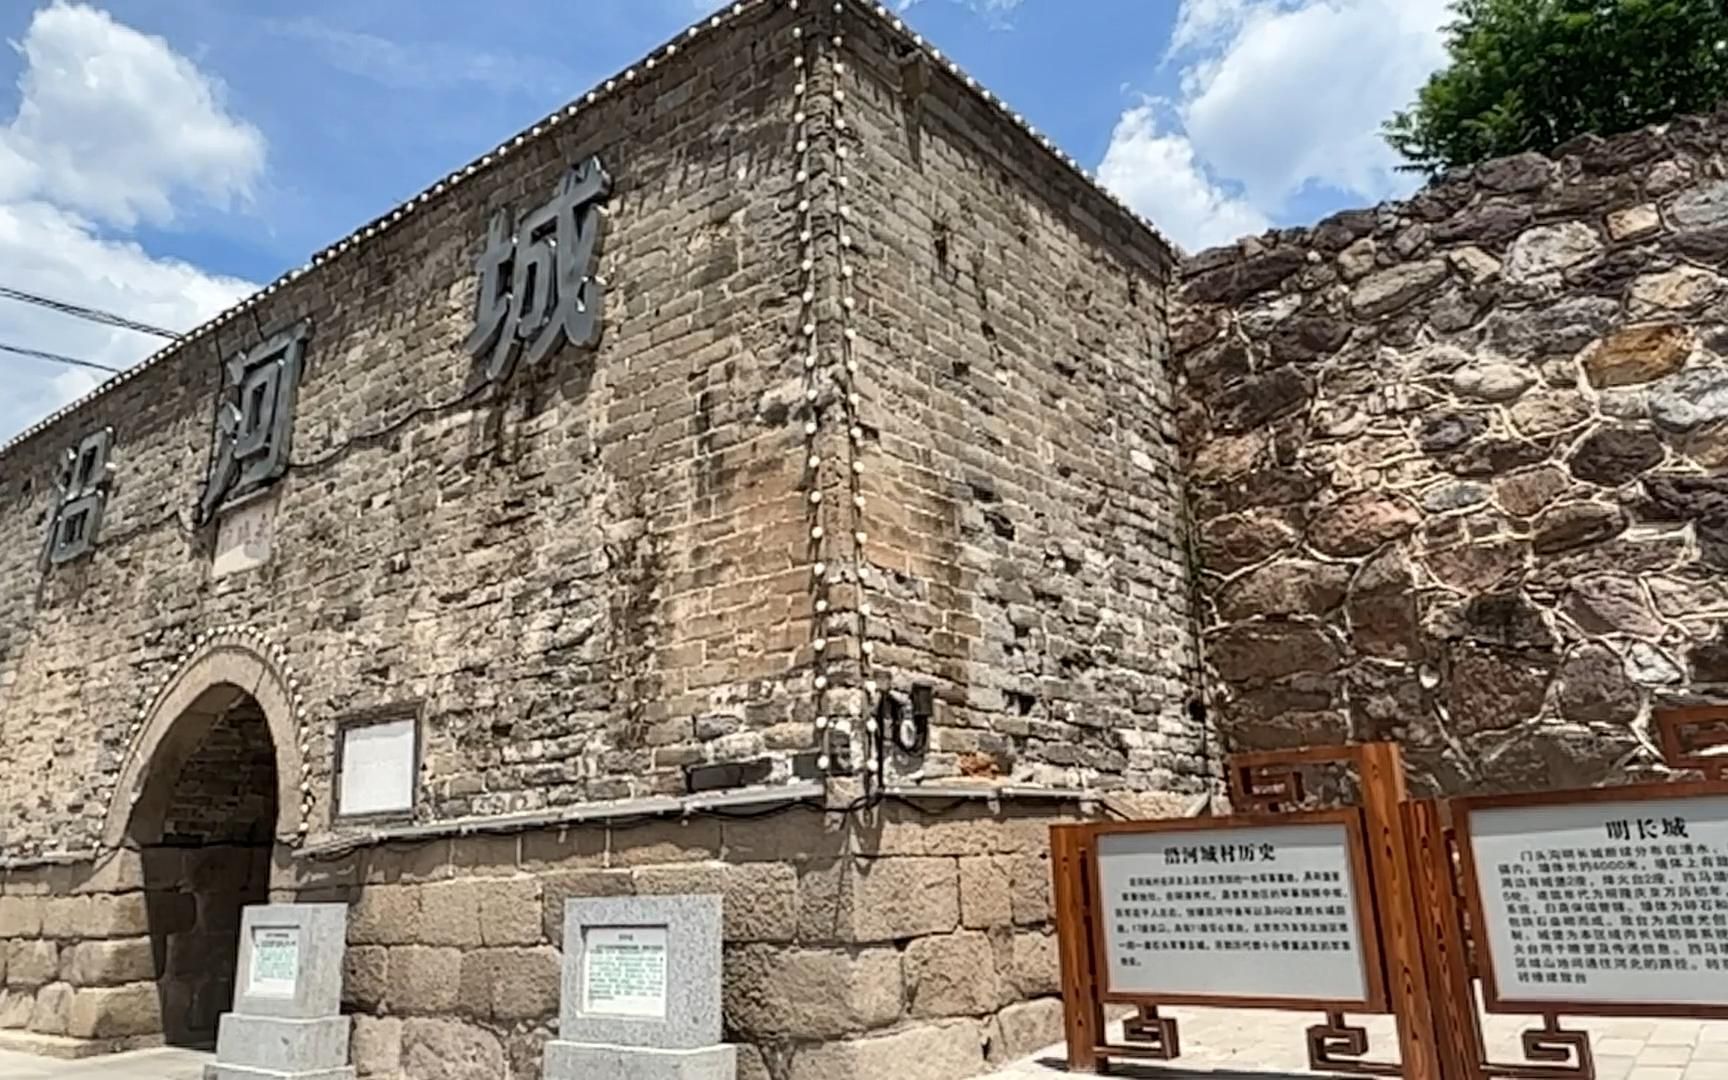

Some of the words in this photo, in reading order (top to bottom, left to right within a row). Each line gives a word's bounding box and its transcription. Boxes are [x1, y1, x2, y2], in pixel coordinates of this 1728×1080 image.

[38, 153, 613, 565] 沿河城
[1606, 817, 1689, 841] 明长城
[1164, 842, 1277, 864] 沿河城村历史
